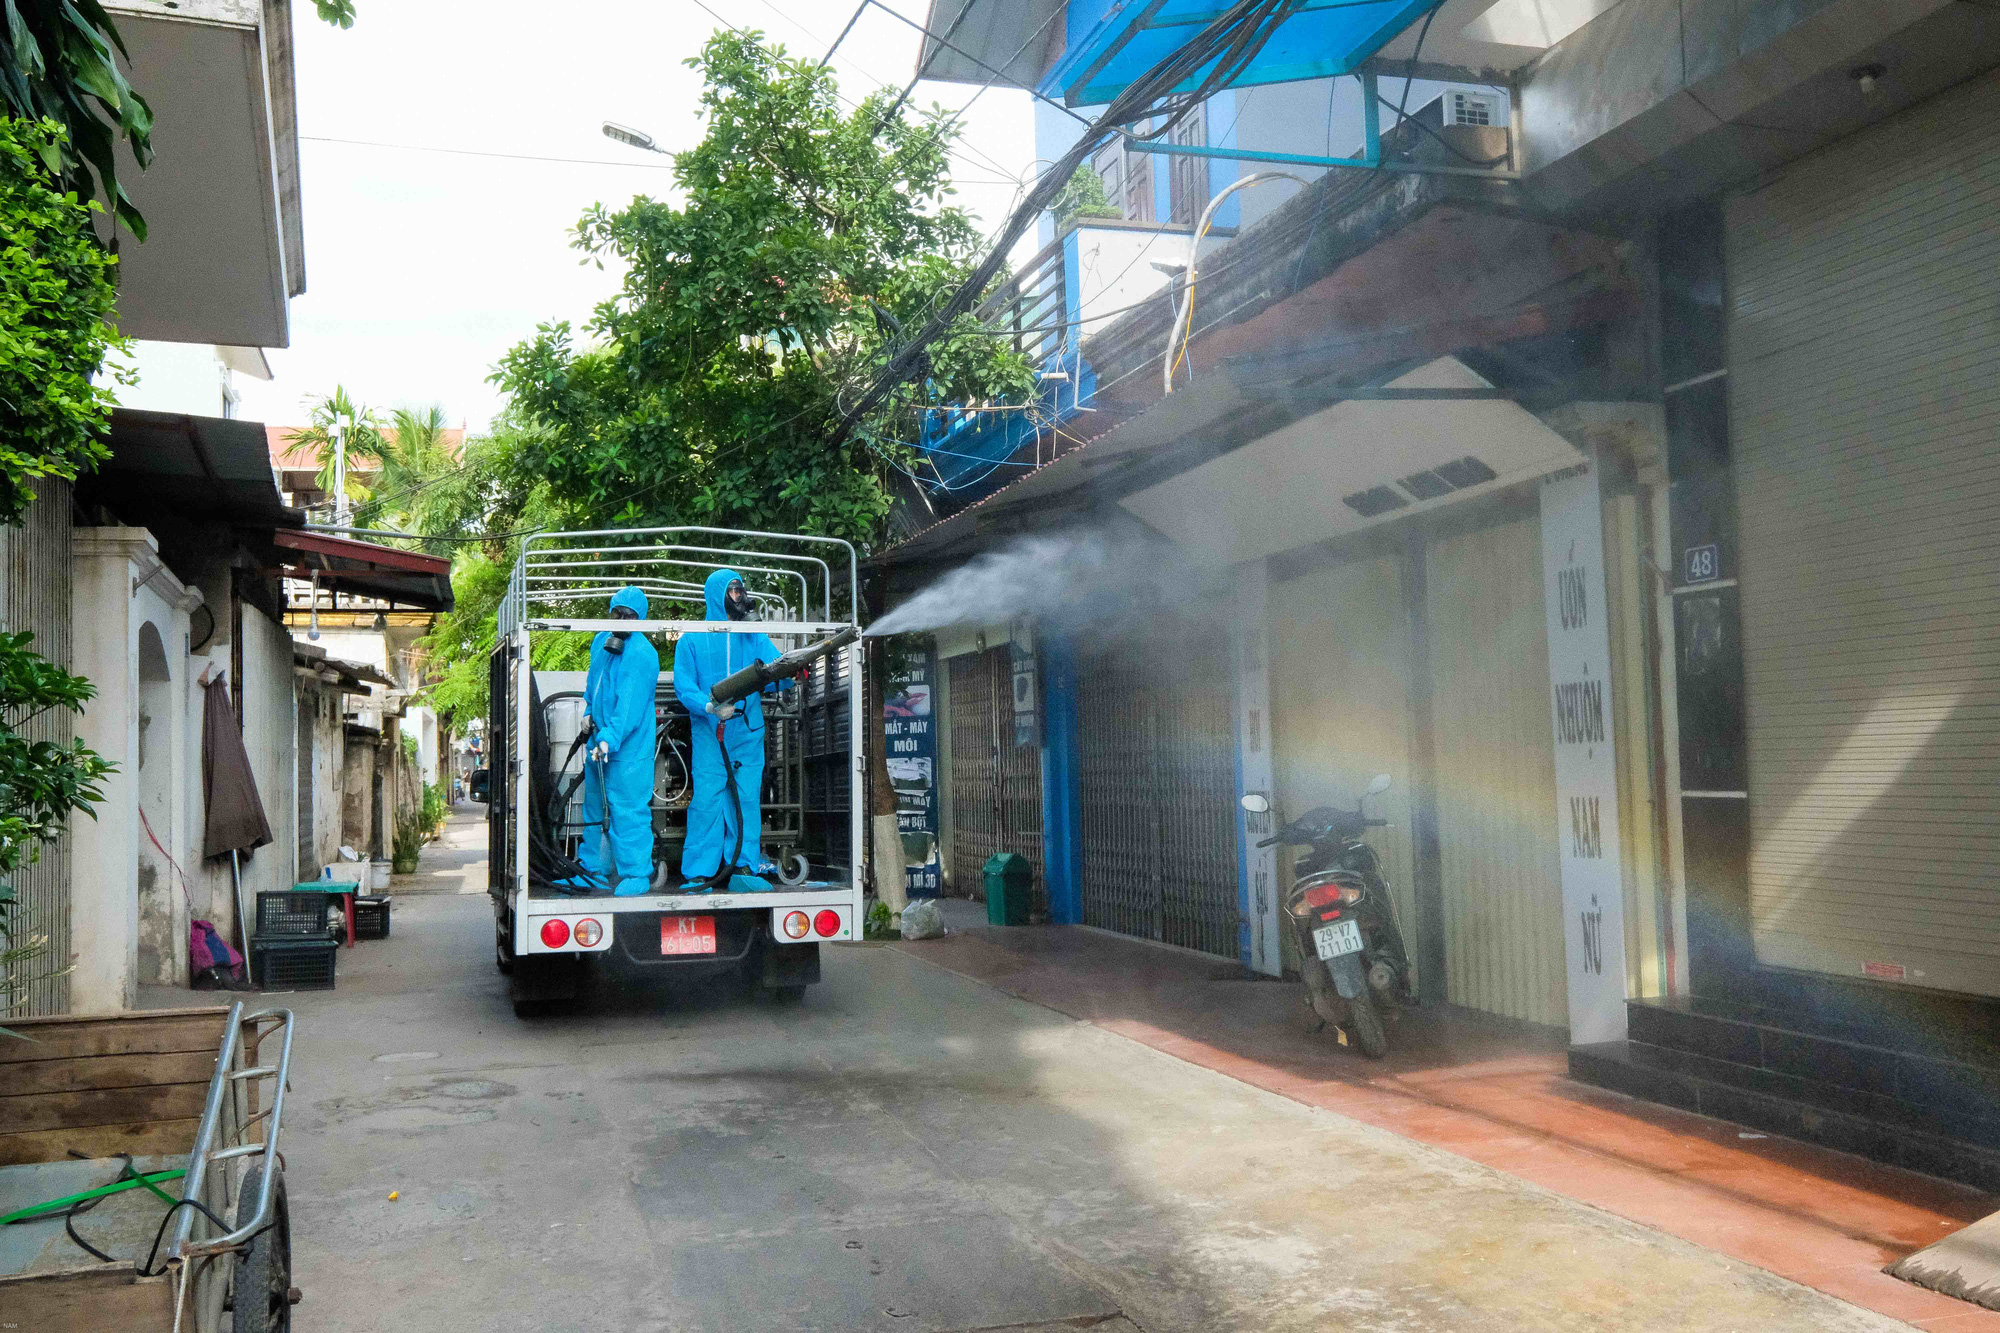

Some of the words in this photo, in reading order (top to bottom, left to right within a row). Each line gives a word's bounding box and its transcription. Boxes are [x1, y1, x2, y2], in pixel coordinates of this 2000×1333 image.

[1691, 550, 1712, 577] 48
[1555, 661, 1605, 760] NHUỘM
[885, 719, 903, 735] MẮT
[909, 719, 928, 734] MÀY
[893, 737, 918, 752] MÔI
[1570, 796, 1602, 860] NAM
[925, 873, 936, 889] 3D
[678, 917, 697, 934] KT
[666, 935, 711, 953] 61-05
